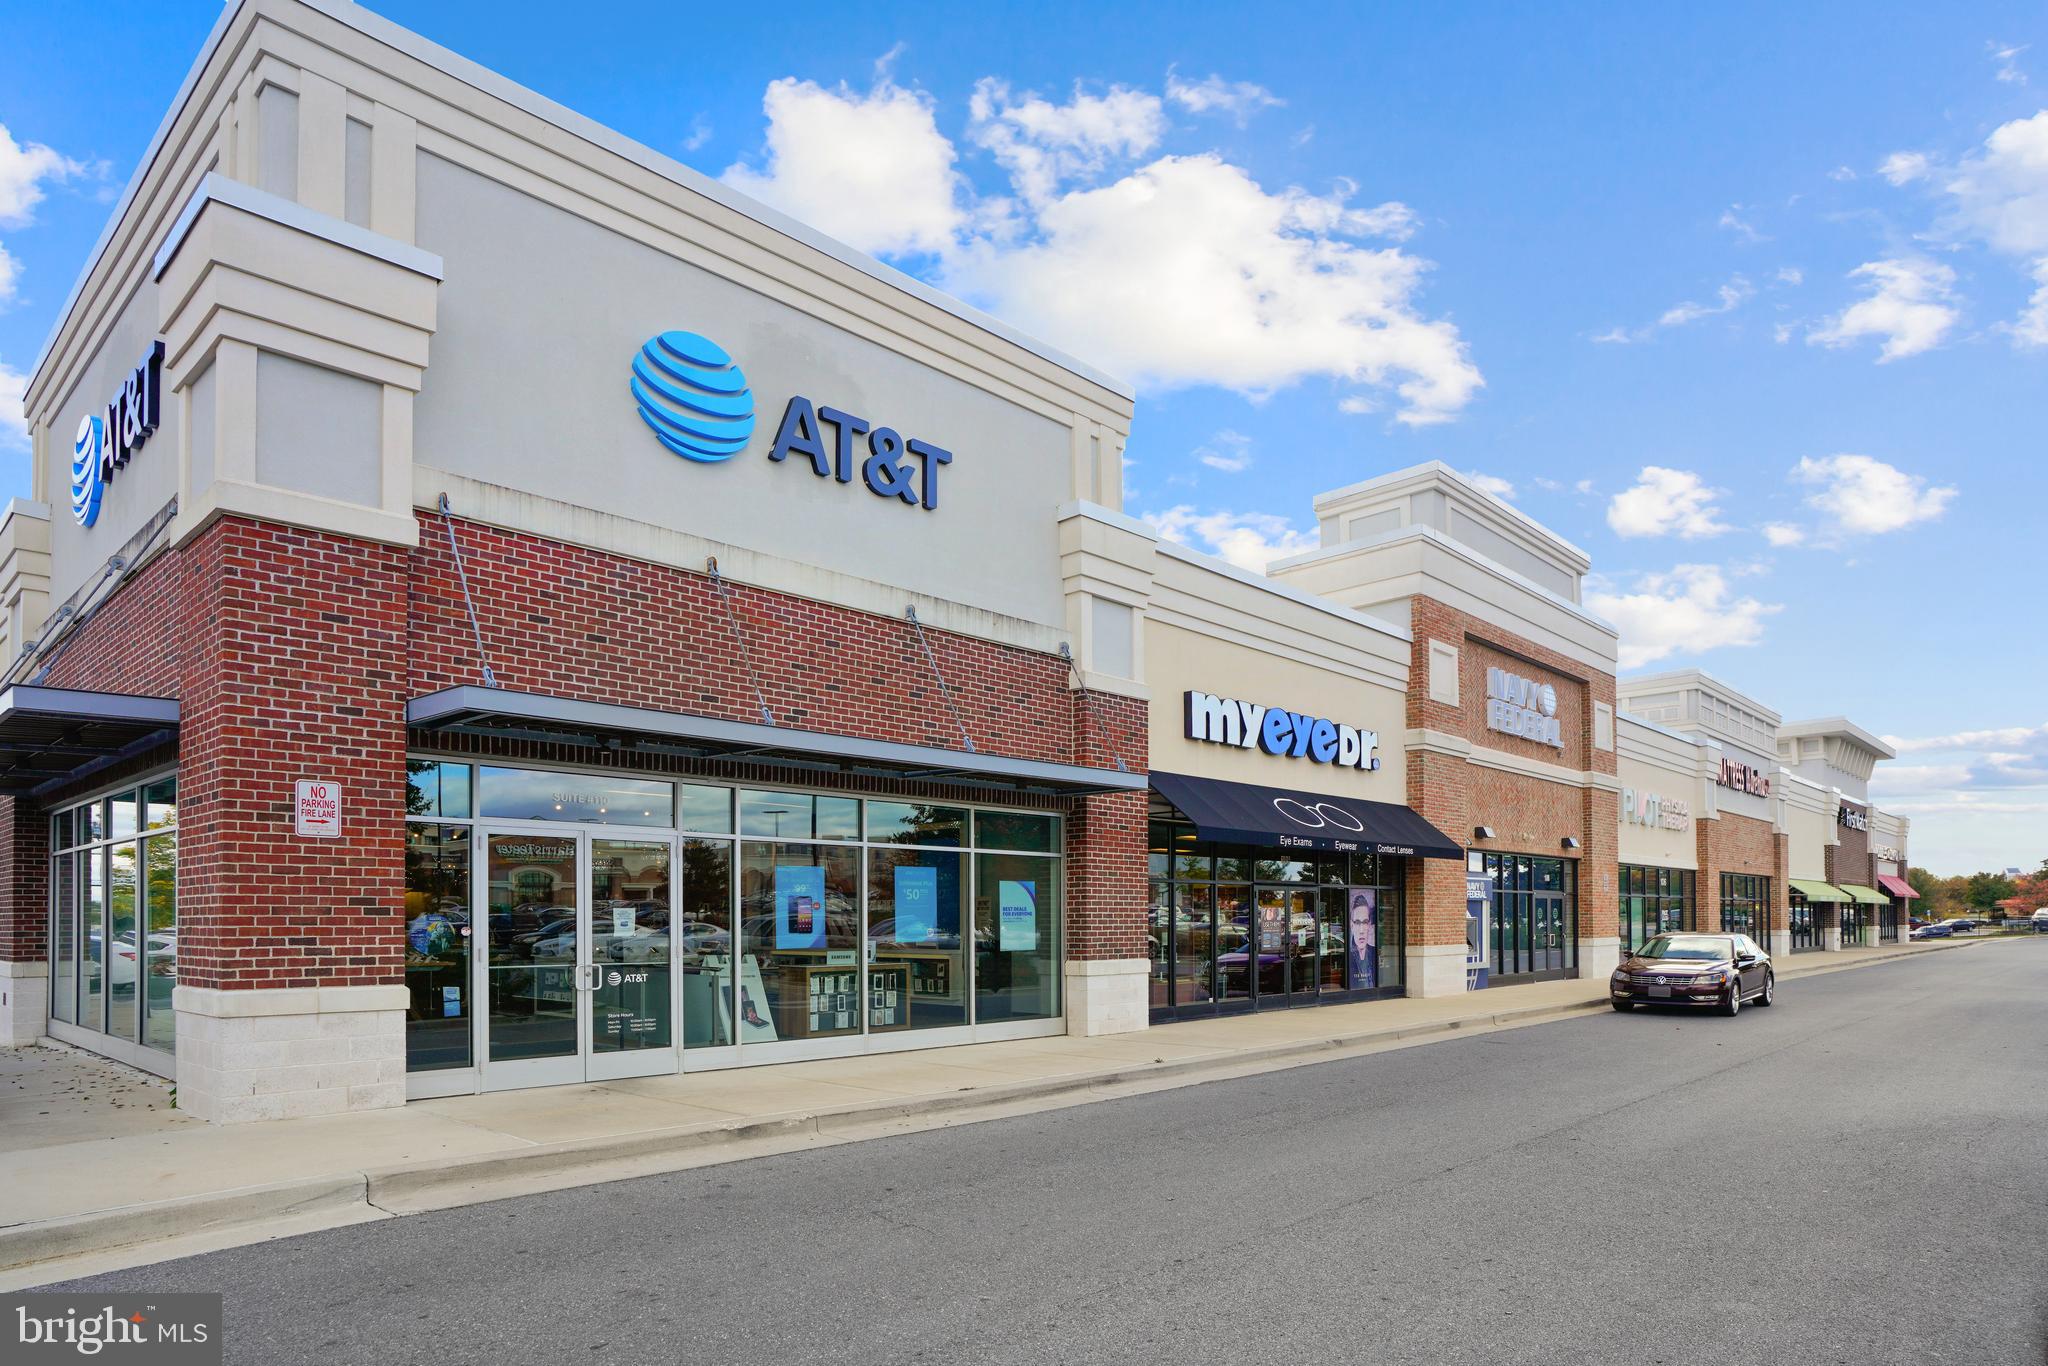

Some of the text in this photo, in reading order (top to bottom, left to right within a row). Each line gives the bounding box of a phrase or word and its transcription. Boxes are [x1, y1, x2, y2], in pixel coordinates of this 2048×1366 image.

[99, 340, 165, 485] AT&T
[768, 395, 952, 510] AT&T
[1487, 667, 1540, 712] NAVY
[1487, 698, 1565, 749] FEDERAL
[311, 786, 326, 799] NO
[552, 792, 585, 803] SUITE
[301, 799, 336, 809] PARKING
[1620, 787, 1661, 828] PIVOT
[301, 809, 336, 818] FIRE LANE
[1280, 836, 1313, 847] Eye Exams
[1335, 841, 1358, 851] Eyewear
[1377, 844, 1414, 855] Contact Lenses
[624, 973, 649, 983] AT&T
